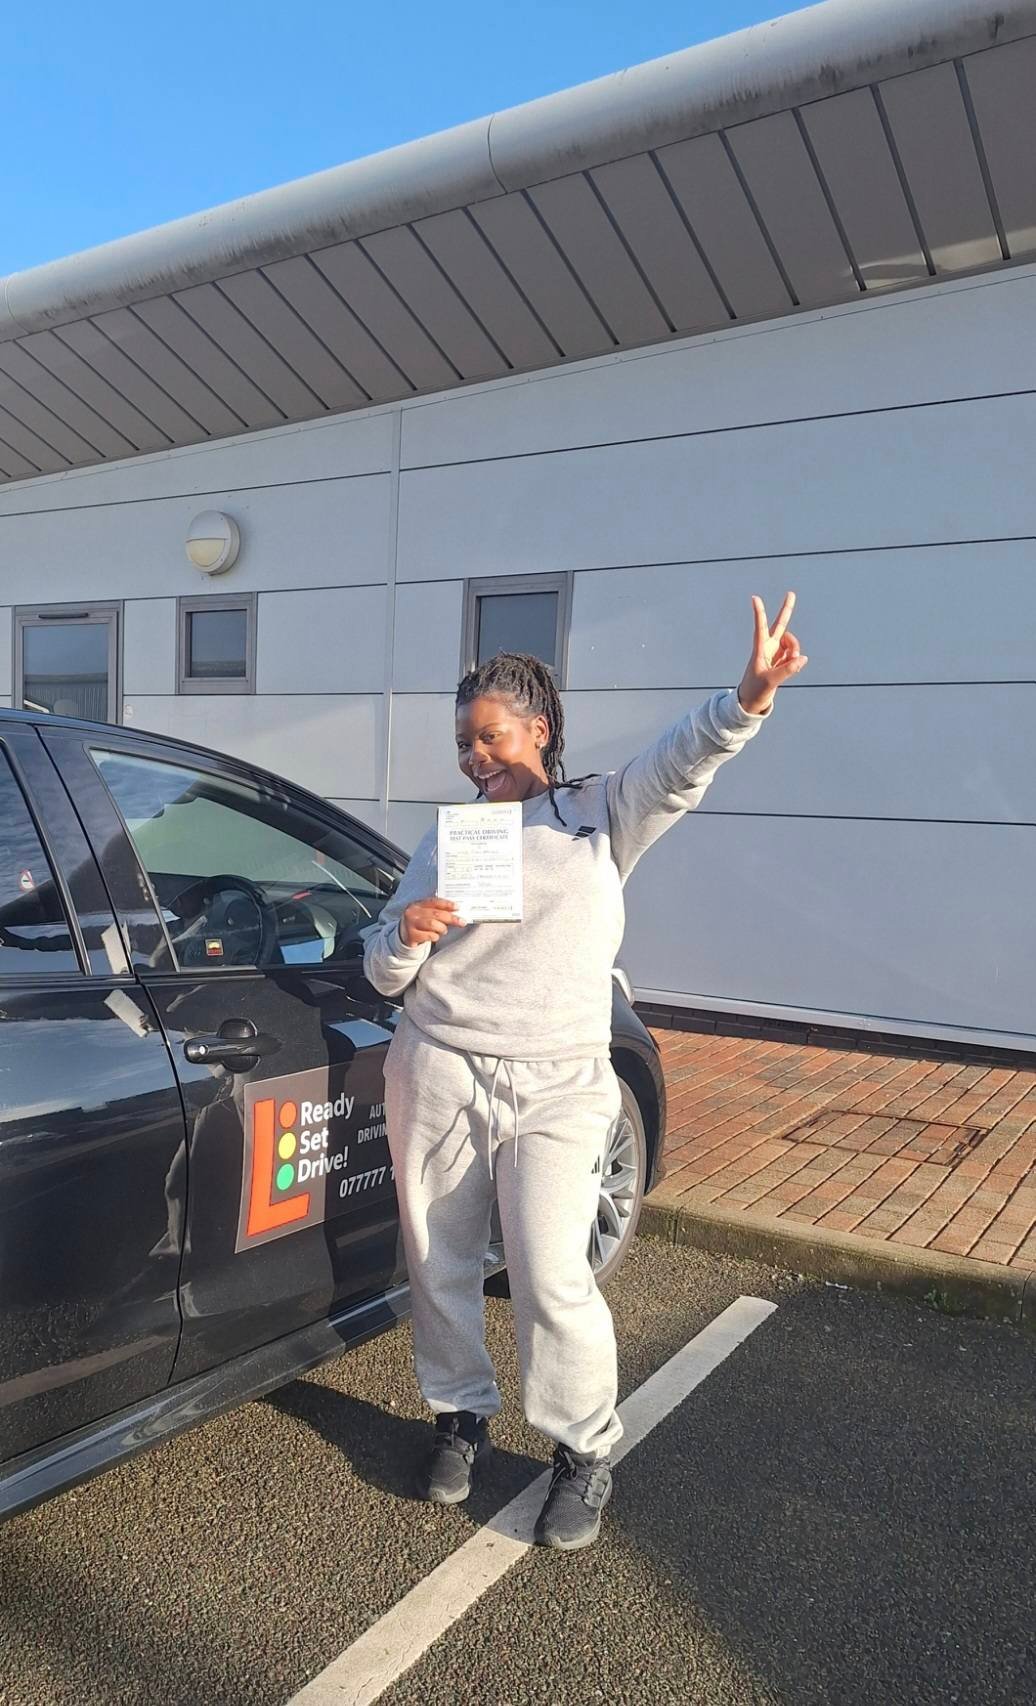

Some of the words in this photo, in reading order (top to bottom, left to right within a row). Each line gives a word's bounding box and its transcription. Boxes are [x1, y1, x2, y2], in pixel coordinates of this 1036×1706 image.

[300, 1092, 354, 1126] Ready
[300, 1127, 329, 1155] Set
[297, 1146, 349, 1183] Drive!
[339, 1166, 387, 1198] 077777
